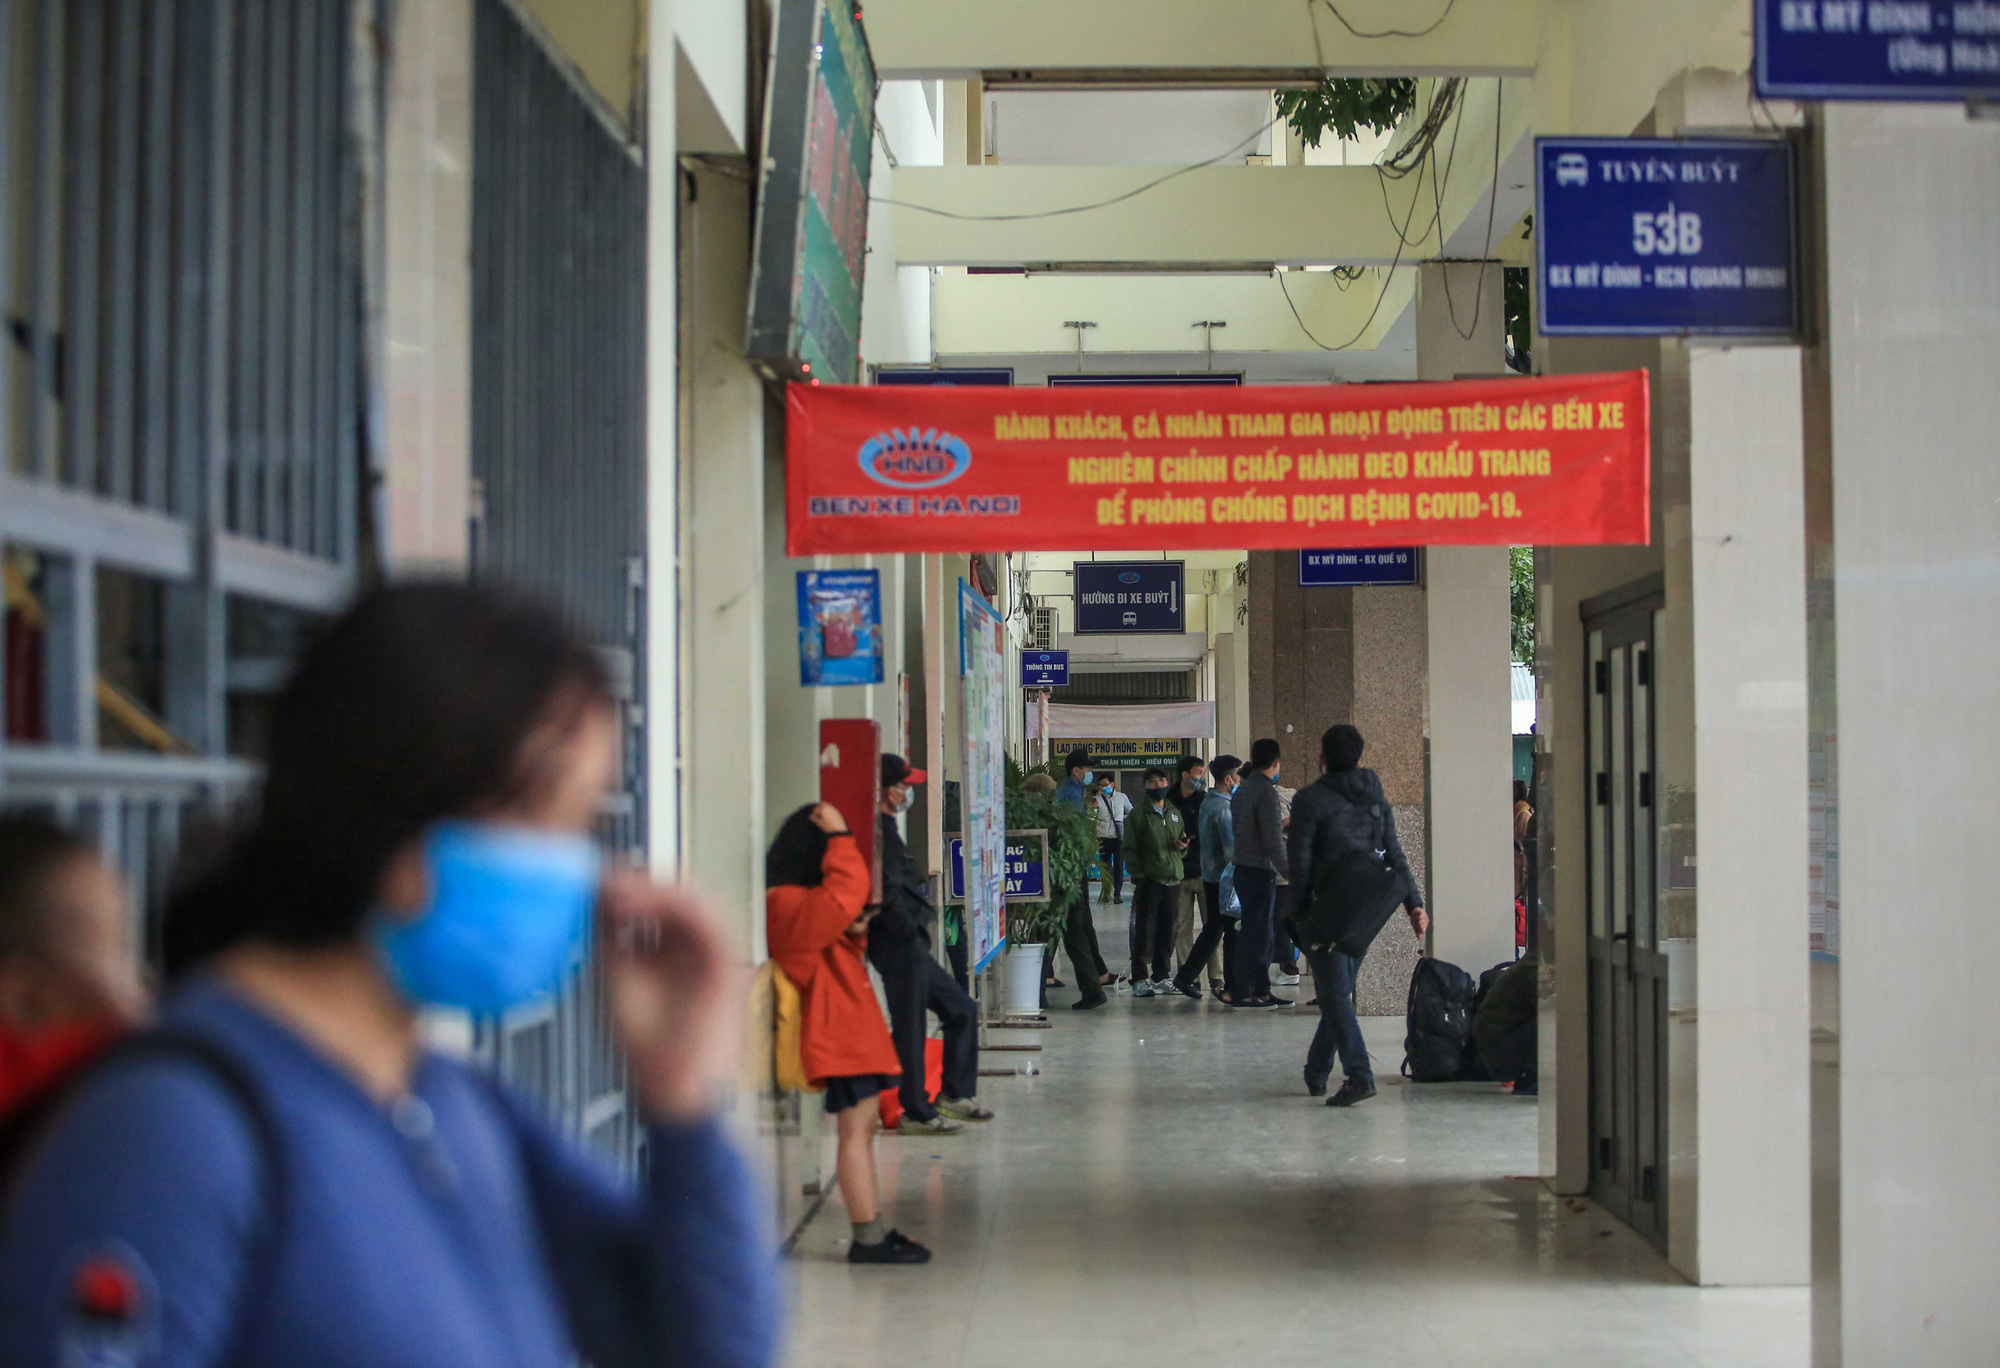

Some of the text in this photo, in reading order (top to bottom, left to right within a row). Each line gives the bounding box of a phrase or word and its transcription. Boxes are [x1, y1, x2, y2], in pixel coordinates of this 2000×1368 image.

[1632, 209, 1702, 256] 53B
[1549, 265, 1573, 288] BX
[995, 396, 1625, 441] HÀNH KHÁCH, CÁ NHÂN THAM GIA HOẠT ĐỘNG TRÊN CÁC BẾN XE
[882, 456, 946, 473] HNB
[1068, 440, 1551, 484] NGHIÊM CHỈNH CHẤP HÀNH ĐEO KHẨU TRANG
[1097, 487, 1522, 528] ĐỂ PHÒNG CHỐNG DỊCH BỆNH COVID-19.
[1308, 555, 1320, 565] BX
[1322, 554, 1335, 565] MỸ
[1337, 553, 1357, 565] ĐÌNH
[1365, 554, 1376, 564] BX
[1378, 552, 1394, 564] QUẾ
[1082, 590, 1169, 604] HƯỚNG ĐI XE BUÝT
[1025, 663, 1043, 671] THÔNG
[1053, 663, 1065, 671] BUS
[1056, 743, 1070, 753] LAO
[1095, 739, 1110, 753] PHỔ
[1112, 741, 1137, 753] THÔNG
[1144, 738, 1163, 752] MIỄN
[1165, 740, 1178, 752] PHÍ
[1101, 758, 1118, 766] THÂN
[1120, 758, 1140, 766] THIỆN
[1146, 758, 1161, 766] HIỆU
[1163, 757, 1177, 765] QUẢ
[1014, 862, 1028, 874] ĐI
[1006, 878, 1023, 892] ÀY
